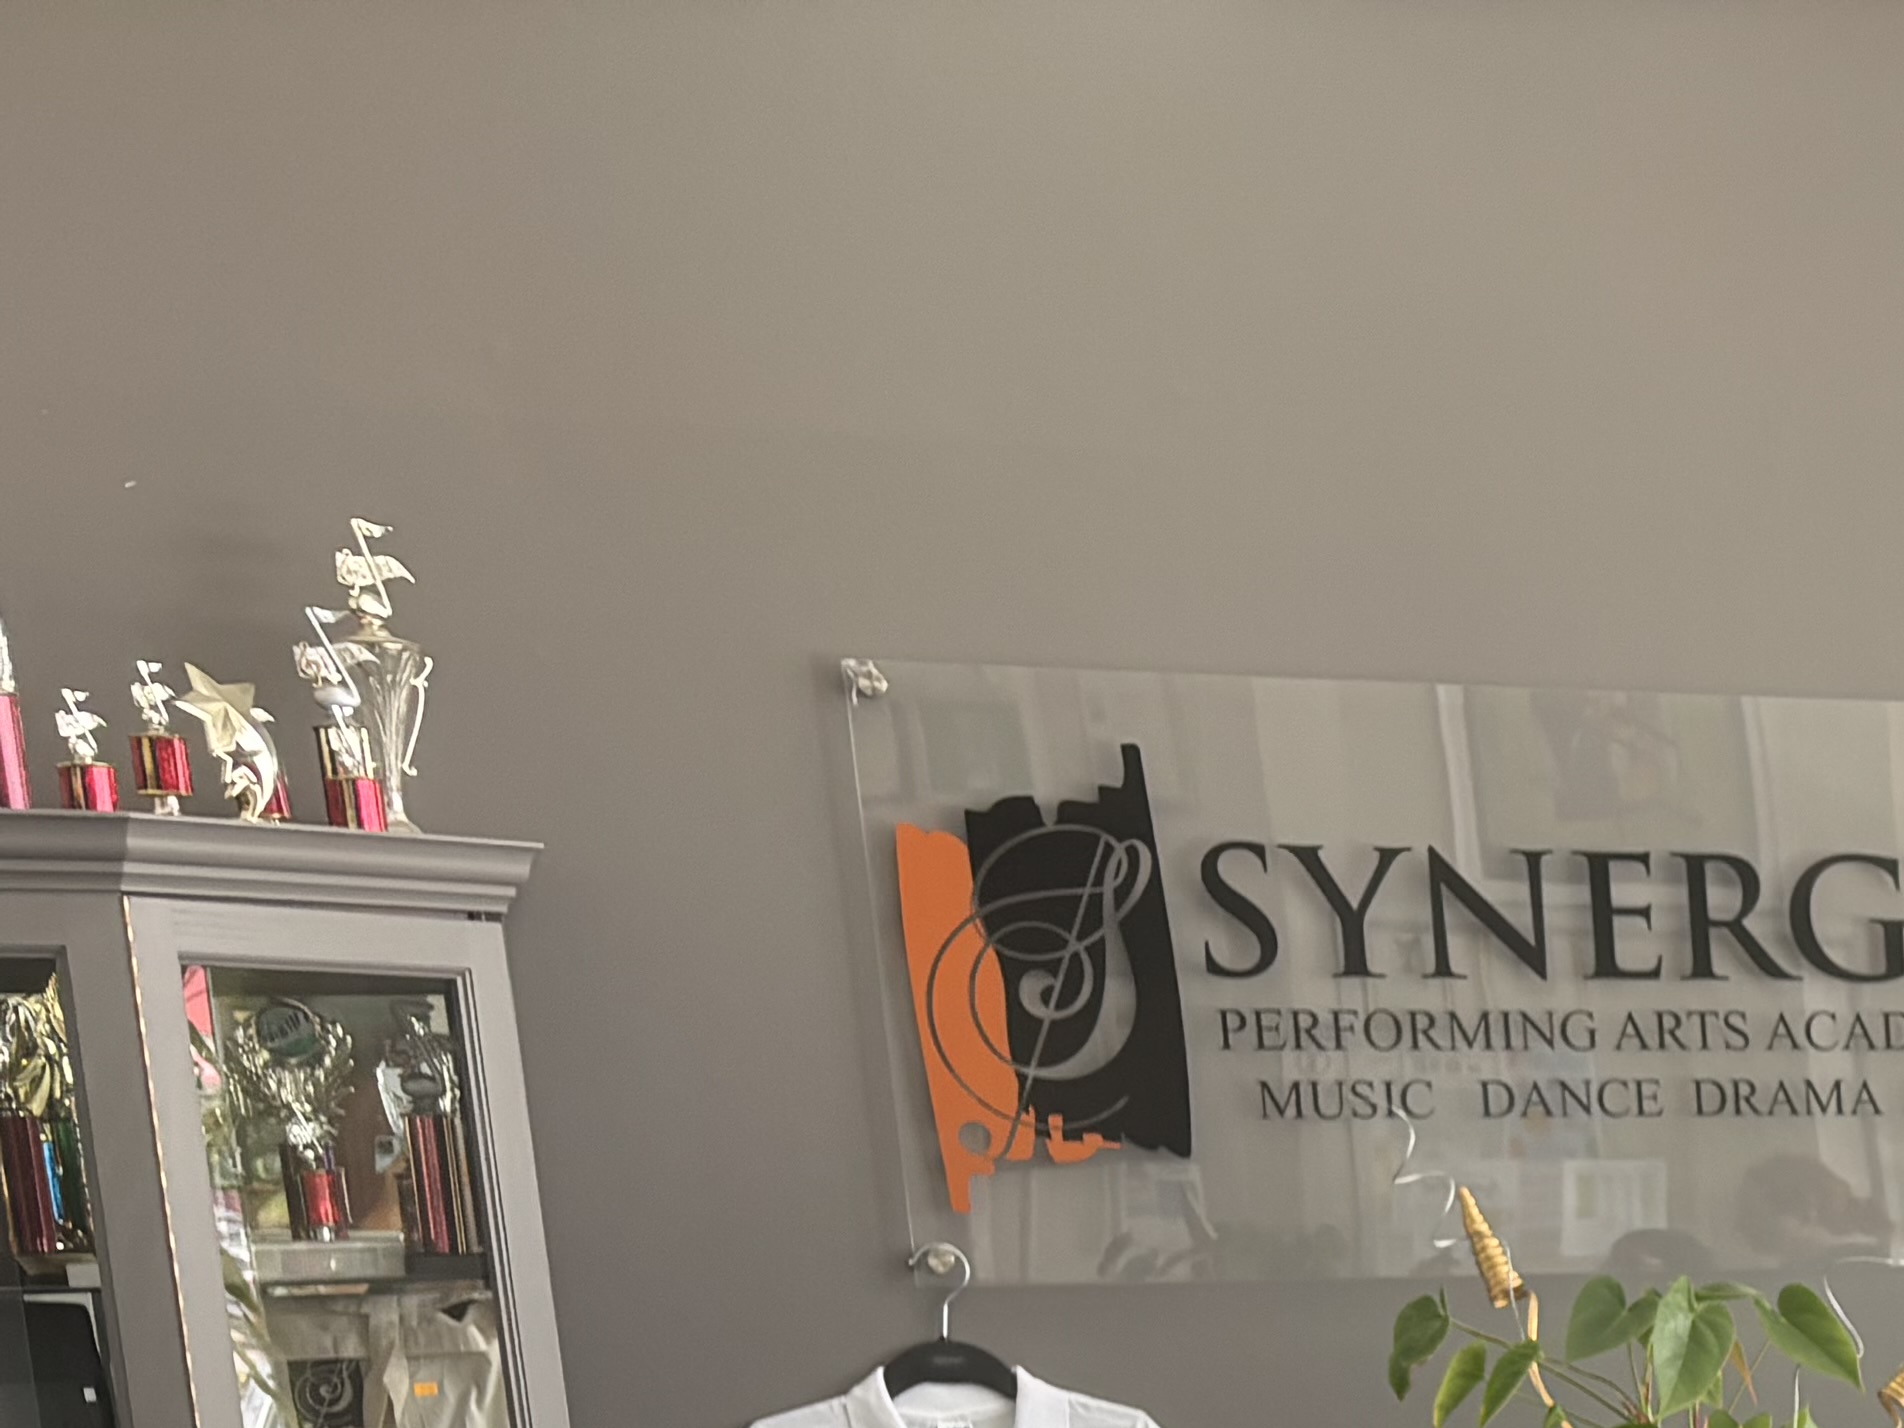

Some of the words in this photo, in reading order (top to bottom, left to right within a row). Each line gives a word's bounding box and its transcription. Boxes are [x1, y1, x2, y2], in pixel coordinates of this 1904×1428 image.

[1219, 1007, 1598, 1054] PERFORMING
[1614, 1008, 1750, 1053] ARTS
[1259, 1078, 1434, 1121] MUSIC
[1480, 1079, 1664, 1120] DANCE
[1694, 1077, 1882, 1119] DRAMA
